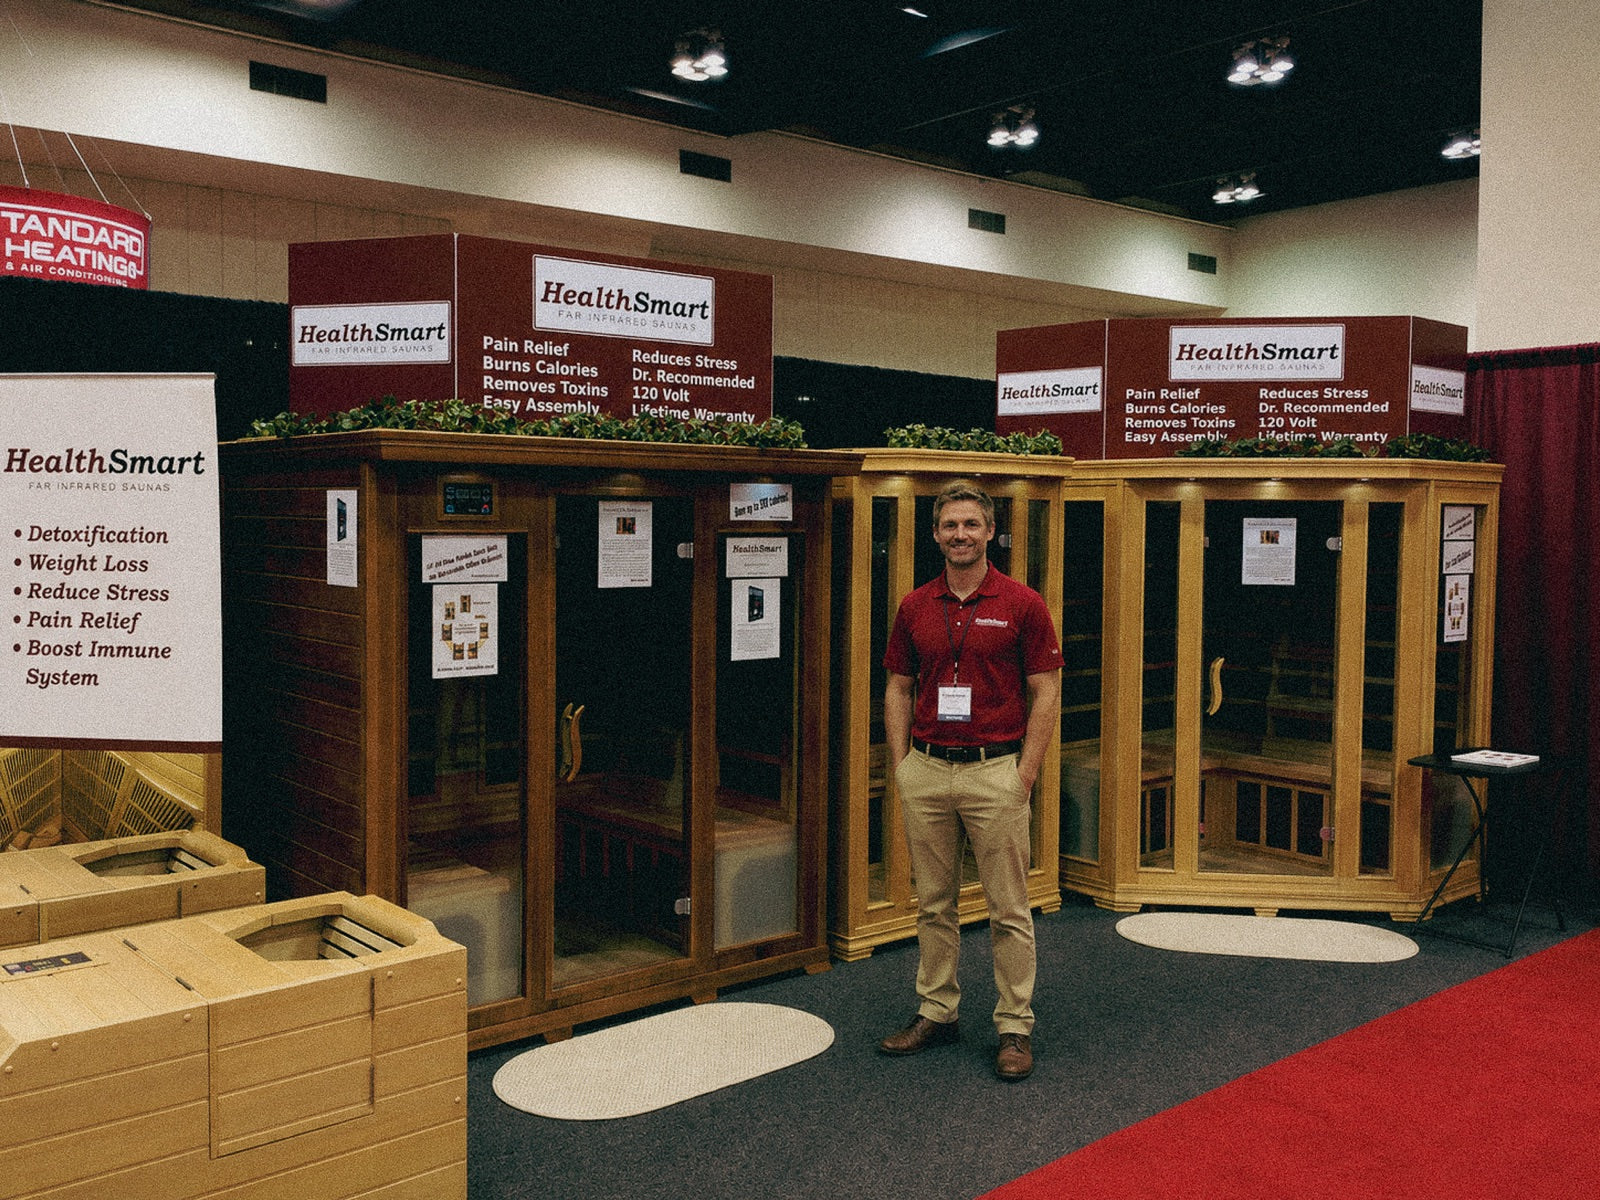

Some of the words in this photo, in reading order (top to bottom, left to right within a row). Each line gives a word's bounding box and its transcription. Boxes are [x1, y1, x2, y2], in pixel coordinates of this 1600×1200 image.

[20, 263, 43, 274] AIR
[541, 280, 710, 320] HealthSmart
[558, 310, 582, 320] FAR
[588, 313, 647, 327] INFRARED
[653, 319, 696, 331] SAUNAS
[298, 322, 446, 343] HealthSmart
[483, 336, 519, 352] Pain
[524, 340, 570, 356] Relief
[1175, 343, 1340, 361] HealthSmart
[483, 355, 531, 372] Burns
[535, 360, 598, 377] Calories
[632, 349, 692, 366] Reduces
[695, 355, 738, 370] Stress
[483, 375, 556, 393] Removes
[560, 381, 609, 397] Toxins
[632, 368, 652, 381] Dr.
[656, 369, 755, 389] Recommended
[632, 386, 658, 400] 120
[662, 388, 690, 402] Volt
[1001, 382, 1099, 400] HealthSmart
[1126, 388, 1155, 399] Pain
[1160, 388, 1201, 399] Relief
[1259, 388, 1319, 399] Reduces
[1323, 387, 1369, 399] Stress
[1413, 379, 1463, 399] HealthSmart
[483, 395, 521, 414] Easy
[525, 397, 600, 416] Assembly
[1125, 403, 1166, 414] Burns
[1170, 402, 1226, 414] Calories
[1259, 402, 1279, 413] Dr.
[1283, 401, 1389, 413] Recommended
[1125, 417, 1187, 428] Removes
[1190, 417, 1236, 428] Toxins
[1259, 417, 1285, 428] 120
[1289, 416, 1317, 428] Volt
[1125, 431, 1157, 445] Easy
[4, 448, 205, 475] HealthSmart
[28, 482, 51, 491] FAR
[57, 482, 116, 492] INFRARED
[122, 483, 171, 492] SAUNAS
[27, 525, 169, 547] Detoxification
[29, 554, 98, 575] Weight
[103, 555, 149, 573] Loss
[27, 582, 100, 600] Reduce
[106, 584, 170, 602] Stress
[27, 611, 73, 628] Pain
[79, 612, 142, 634] Relief
[26, 640, 83, 657] Boost
[88, 641, 172, 659] Immune
[26, 668, 99, 689] System
